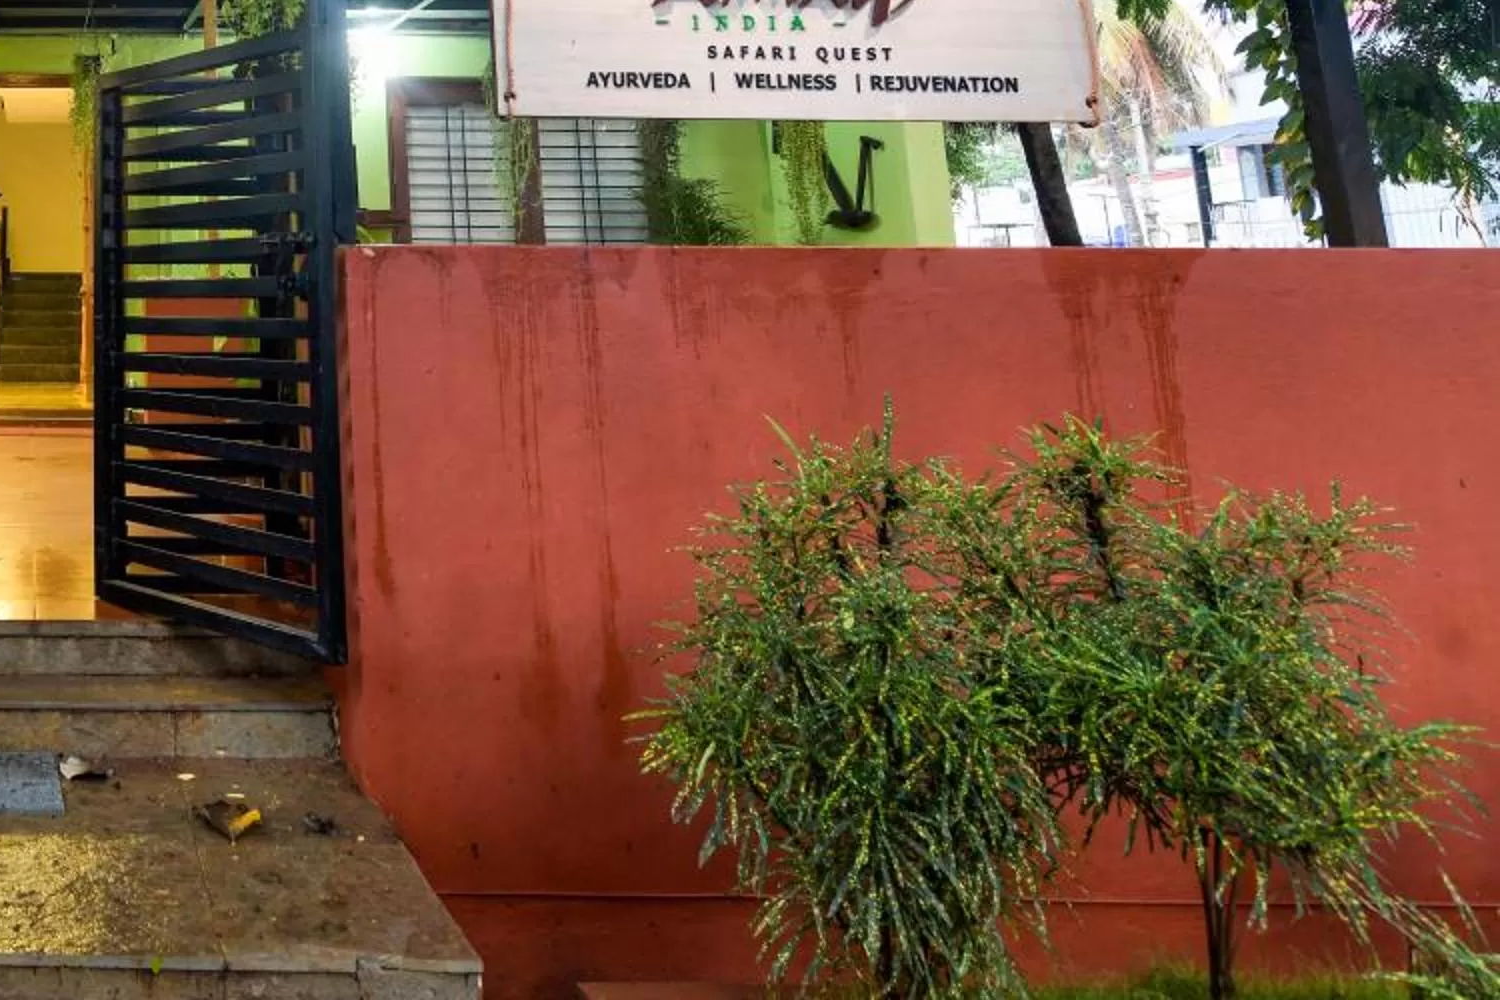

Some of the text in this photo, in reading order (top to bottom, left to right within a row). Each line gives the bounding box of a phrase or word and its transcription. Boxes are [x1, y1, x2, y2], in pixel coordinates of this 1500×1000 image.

[691, 14, 806, 32] INDIA
[707, 45, 893, 62] SAFARI QUEST
[586, 72, 1019, 93] AYURVEDA WELLNESS REJUVENATION
